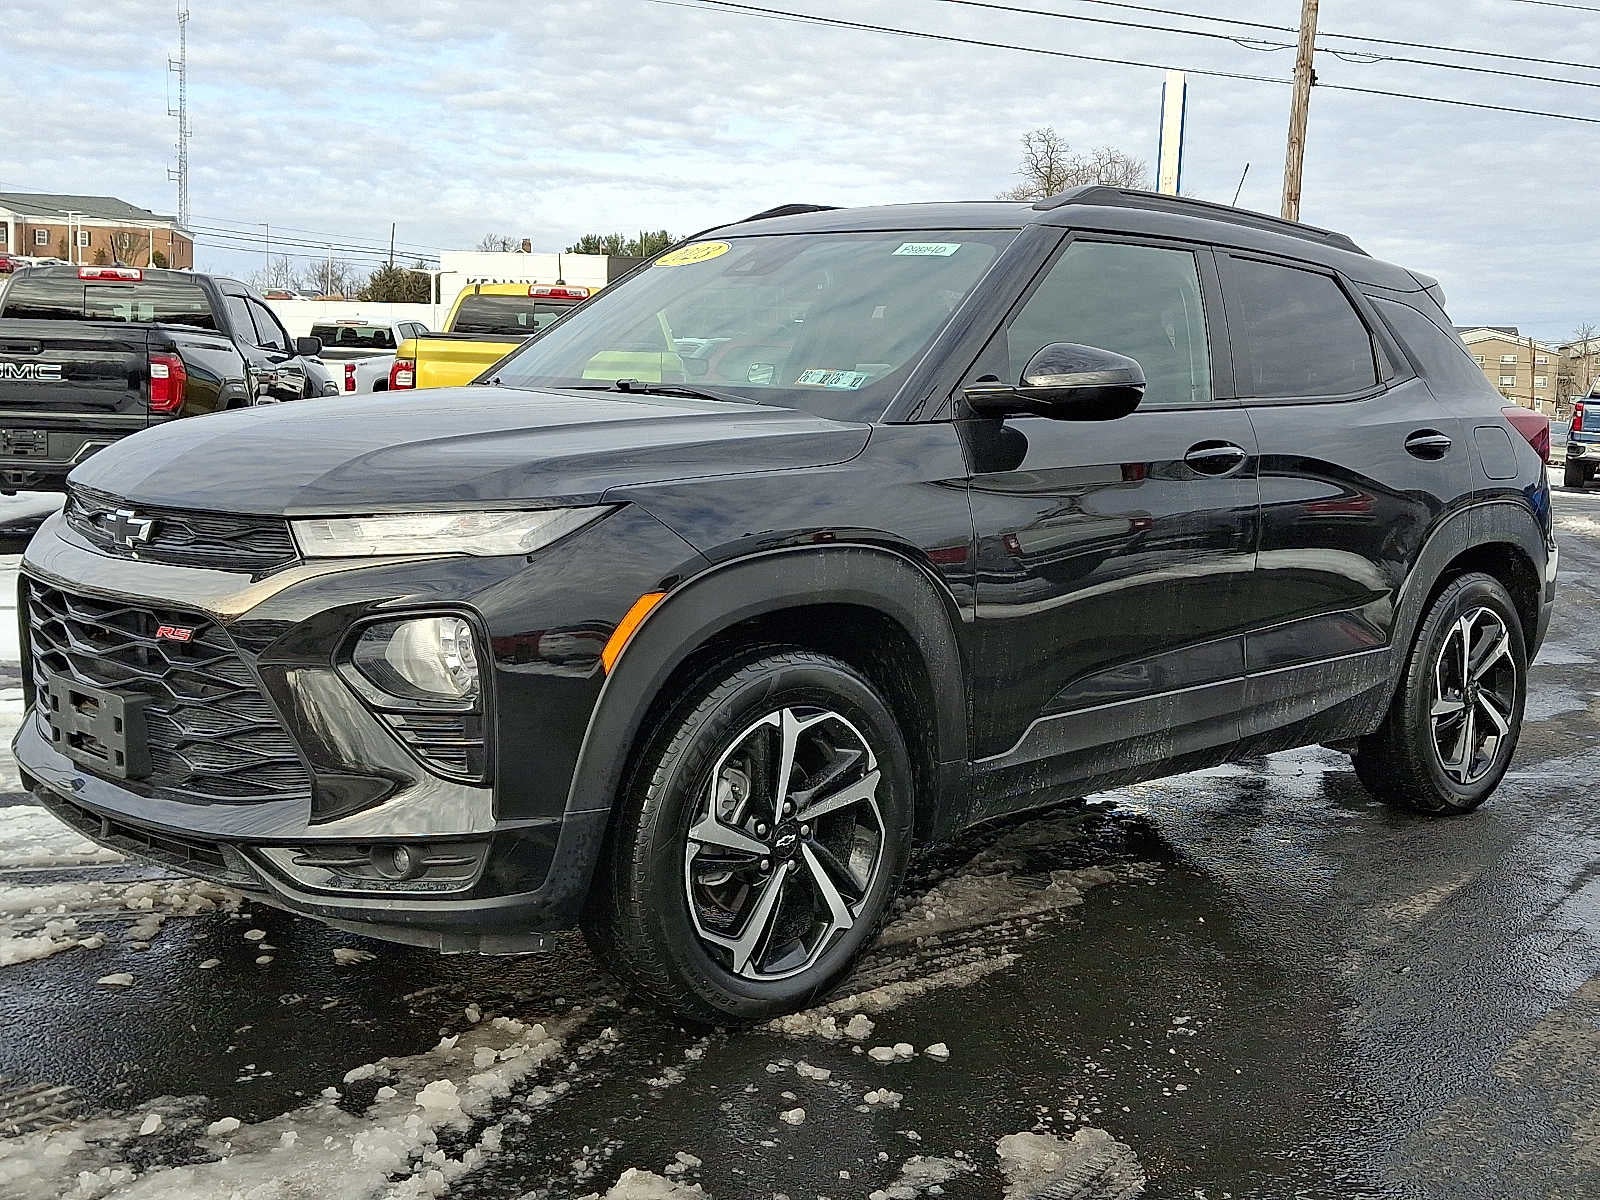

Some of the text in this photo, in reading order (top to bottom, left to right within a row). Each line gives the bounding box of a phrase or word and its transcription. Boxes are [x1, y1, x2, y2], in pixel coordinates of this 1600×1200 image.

[0, 362, 62, 380] MC
[818, 373, 832, 384] 12
[156, 626, 193, 641] RS
